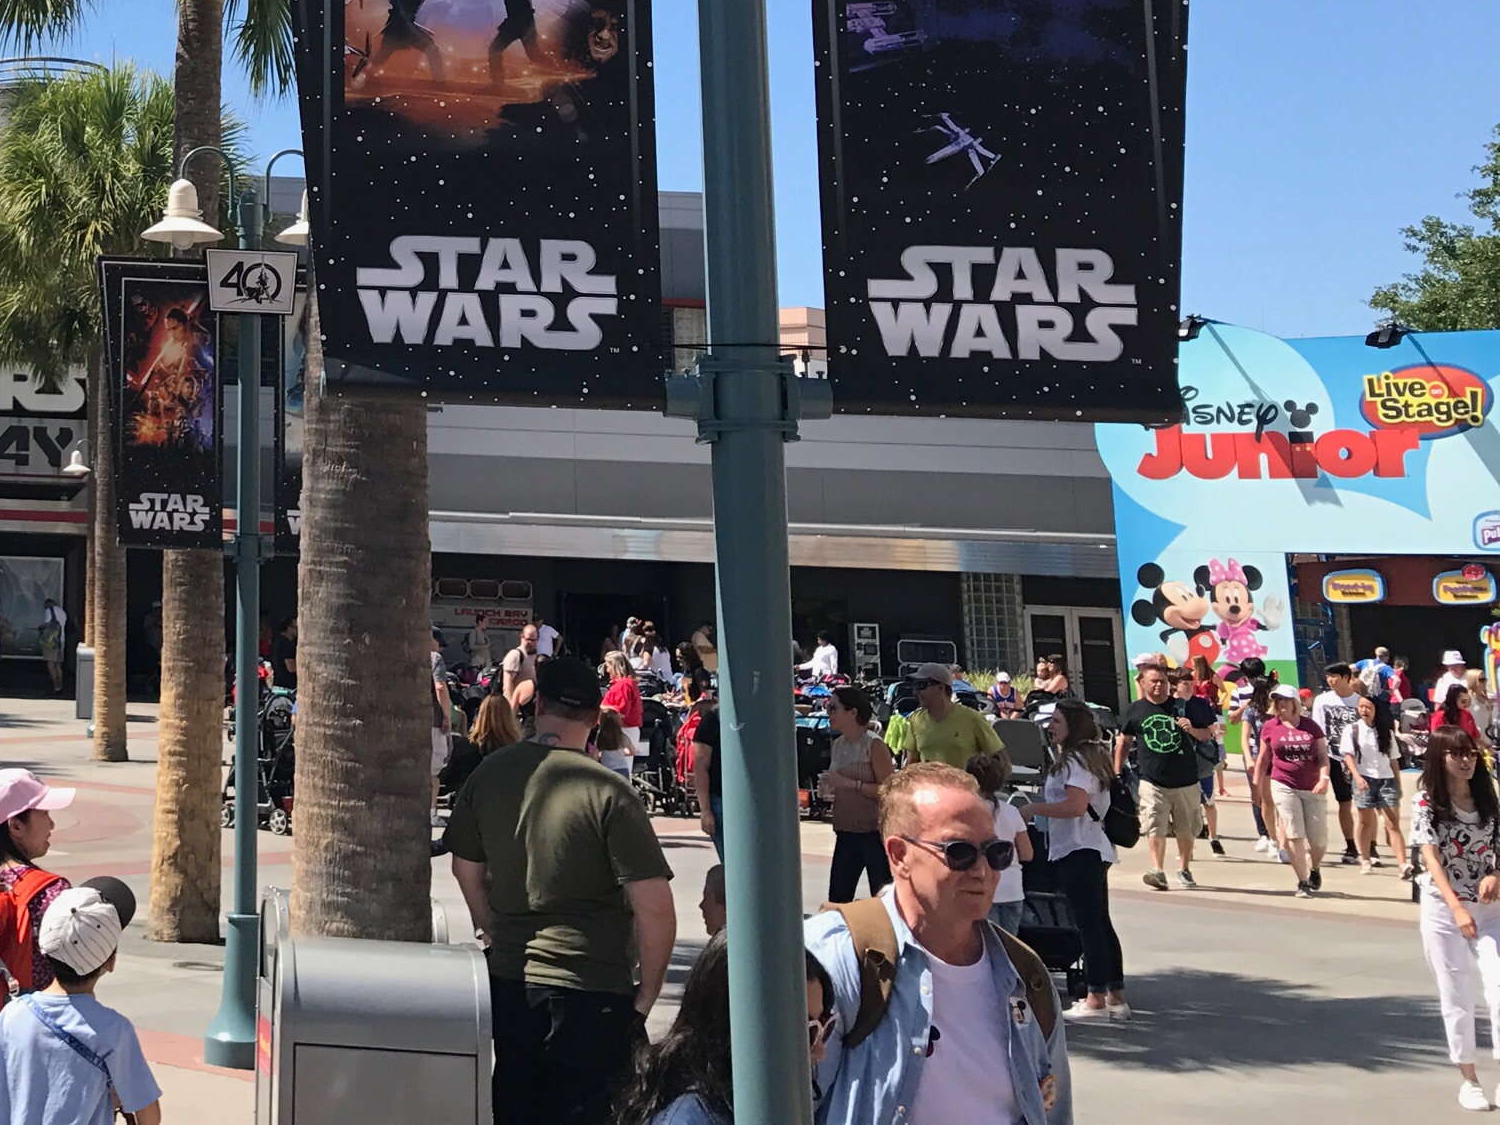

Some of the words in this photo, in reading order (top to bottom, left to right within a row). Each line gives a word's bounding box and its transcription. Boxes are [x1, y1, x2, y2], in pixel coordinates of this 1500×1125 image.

[220, 261, 282, 300] 40
[356, 235, 617, 293] STAR
[867, 245, 1136, 304] STAR
[357, 288, 618, 350] WARS
[867, 300, 1139, 362] WARS
[1367, 374, 1427, 398] Live
[1380, 390, 1480, 424] Stage!
[1137, 424, 1421, 480] Junior
[128, 492, 210, 513] STAR
[129, 510, 211, 531] WARS
[454, 608, 501, 617] LAUNCH
